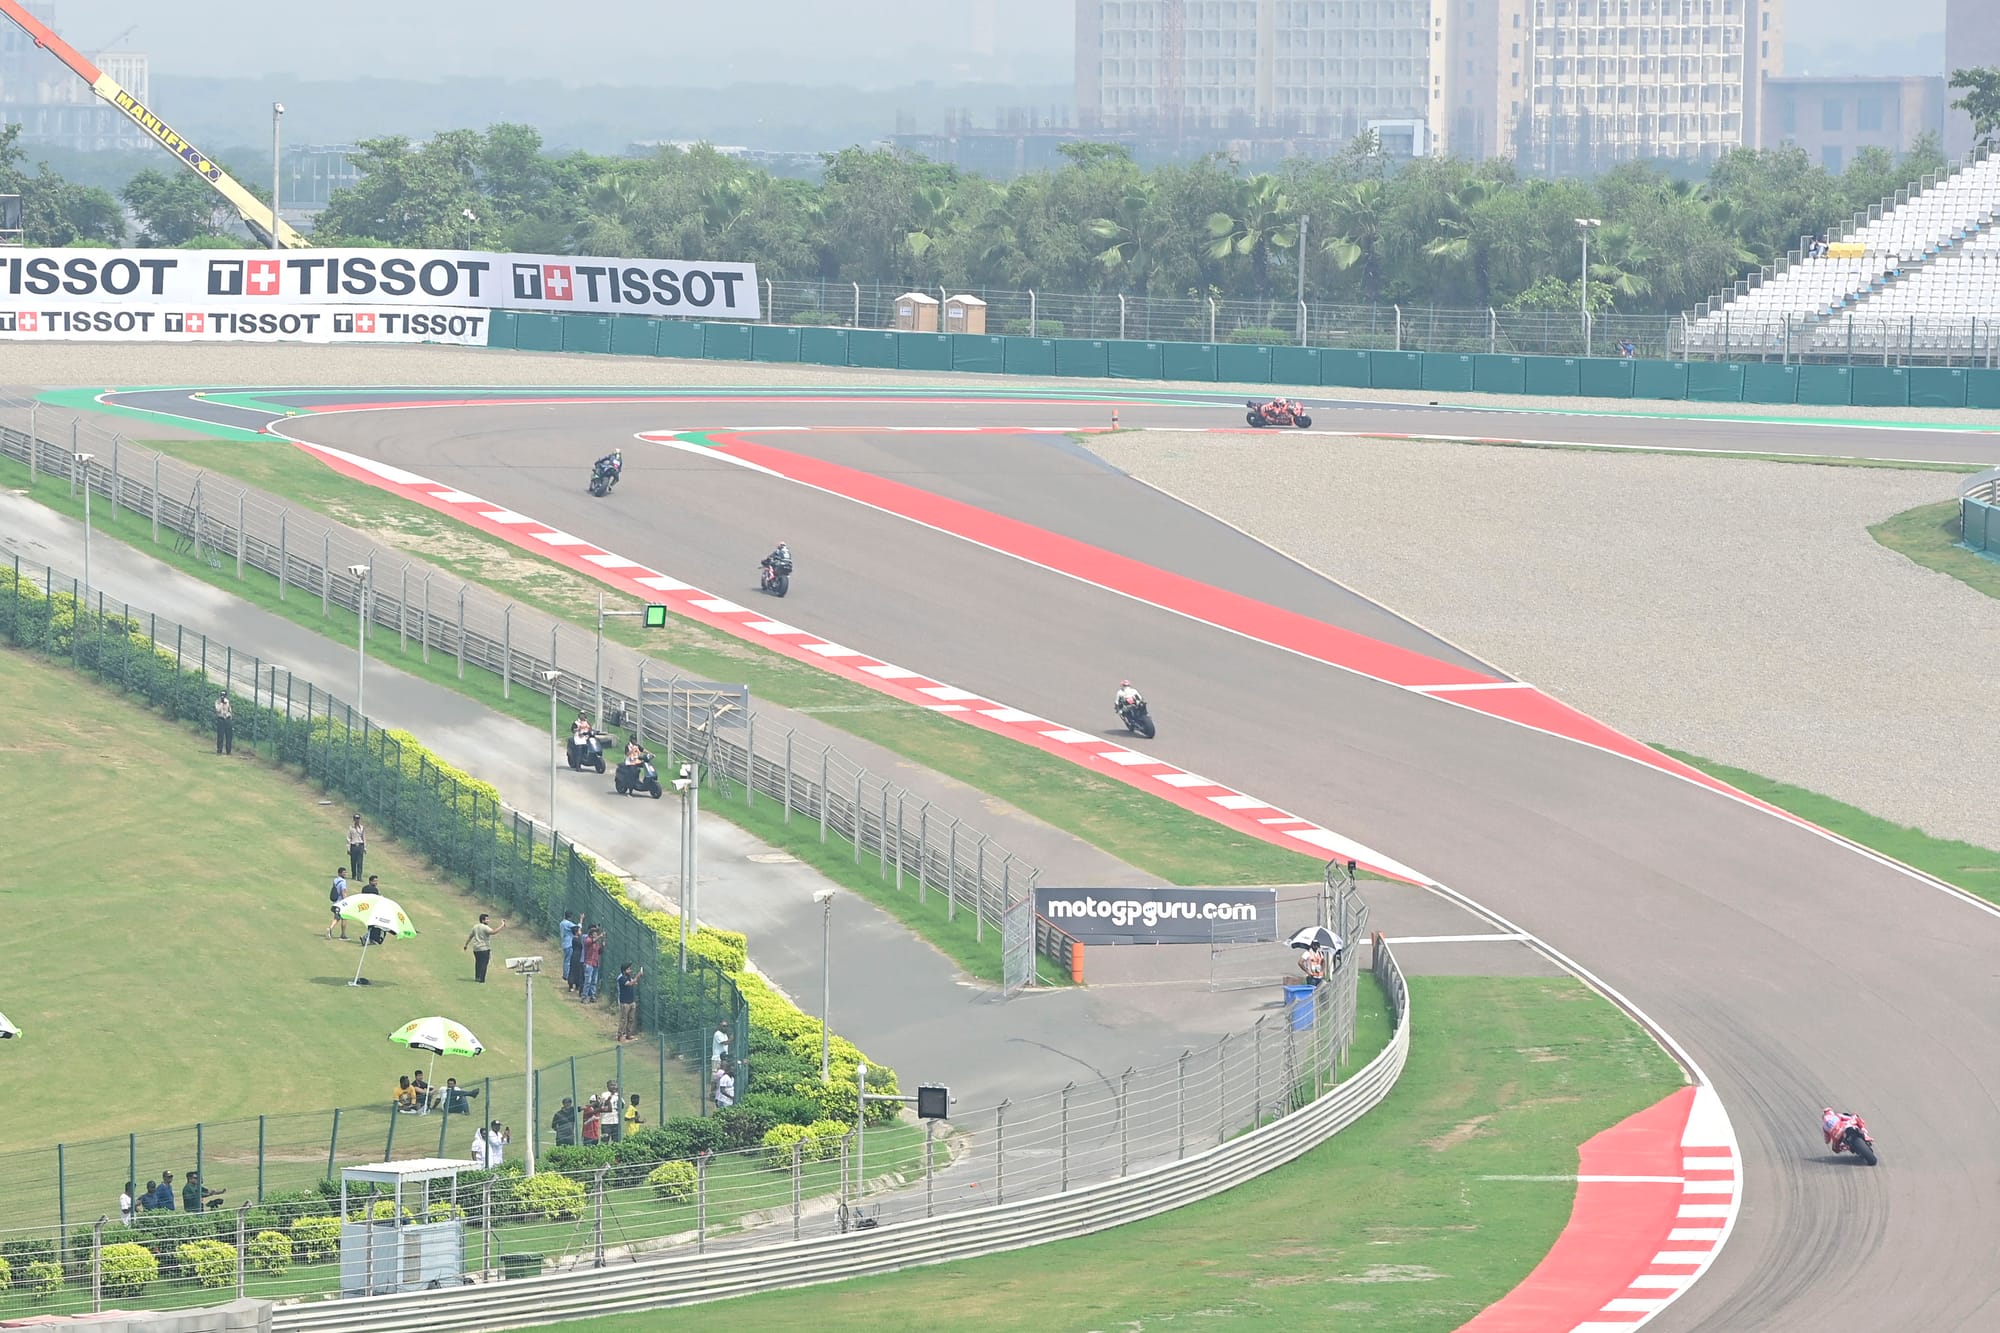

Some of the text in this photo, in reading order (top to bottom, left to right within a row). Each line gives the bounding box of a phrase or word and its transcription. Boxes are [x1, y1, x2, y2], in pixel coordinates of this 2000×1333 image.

[116, 91, 189, 153] MANLIFT
[0, 257, 178, 296] ISSOT
[286, 257, 490, 298] TISSOT
[575, 266, 744, 308] TISSOT
[41, 311, 155, 332] TISSOT
[207, 312, 321, 334] TISSOT
[379, 313, 484, 337] TISSOT
[1048, 896, 1257, 927] motogpguru.com
